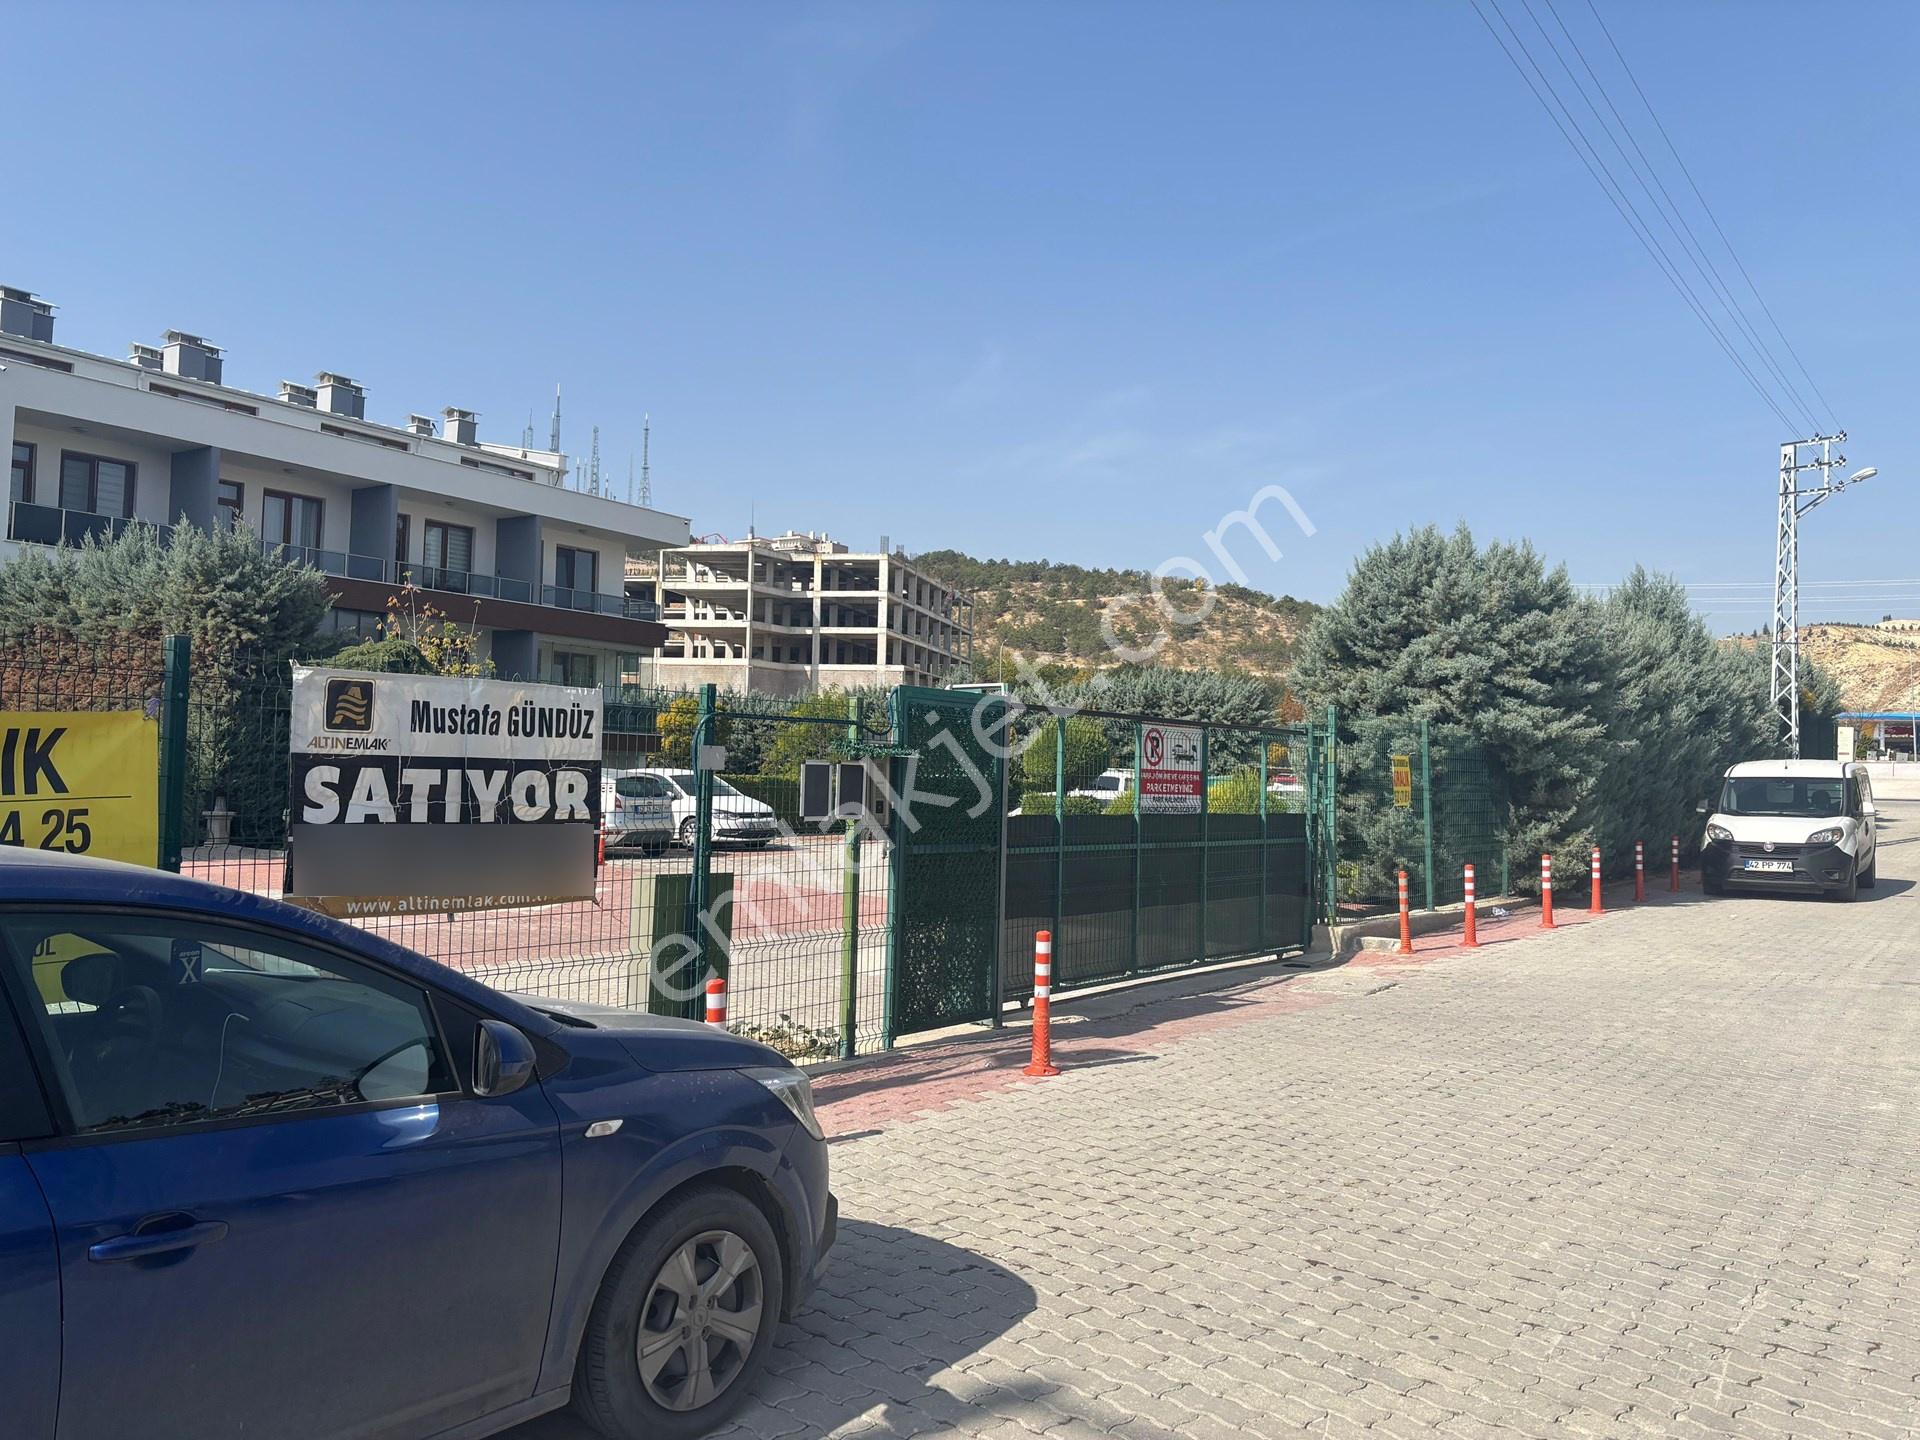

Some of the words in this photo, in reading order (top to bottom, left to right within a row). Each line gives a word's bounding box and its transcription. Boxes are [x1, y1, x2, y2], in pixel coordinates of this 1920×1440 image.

[410, 700, 501, 736] Mustafa
[508, 701, 594, 740] GÜNDÜZ
[307, 736, 388, 751] ALTINEMLAK
[302, 765, 591, 825] SATIYOR
[1146, 783, 1162, 792] PARK
[40, 808, 91, 854] 25
[347, 896, 547, 914] www.altinemlak.com.
